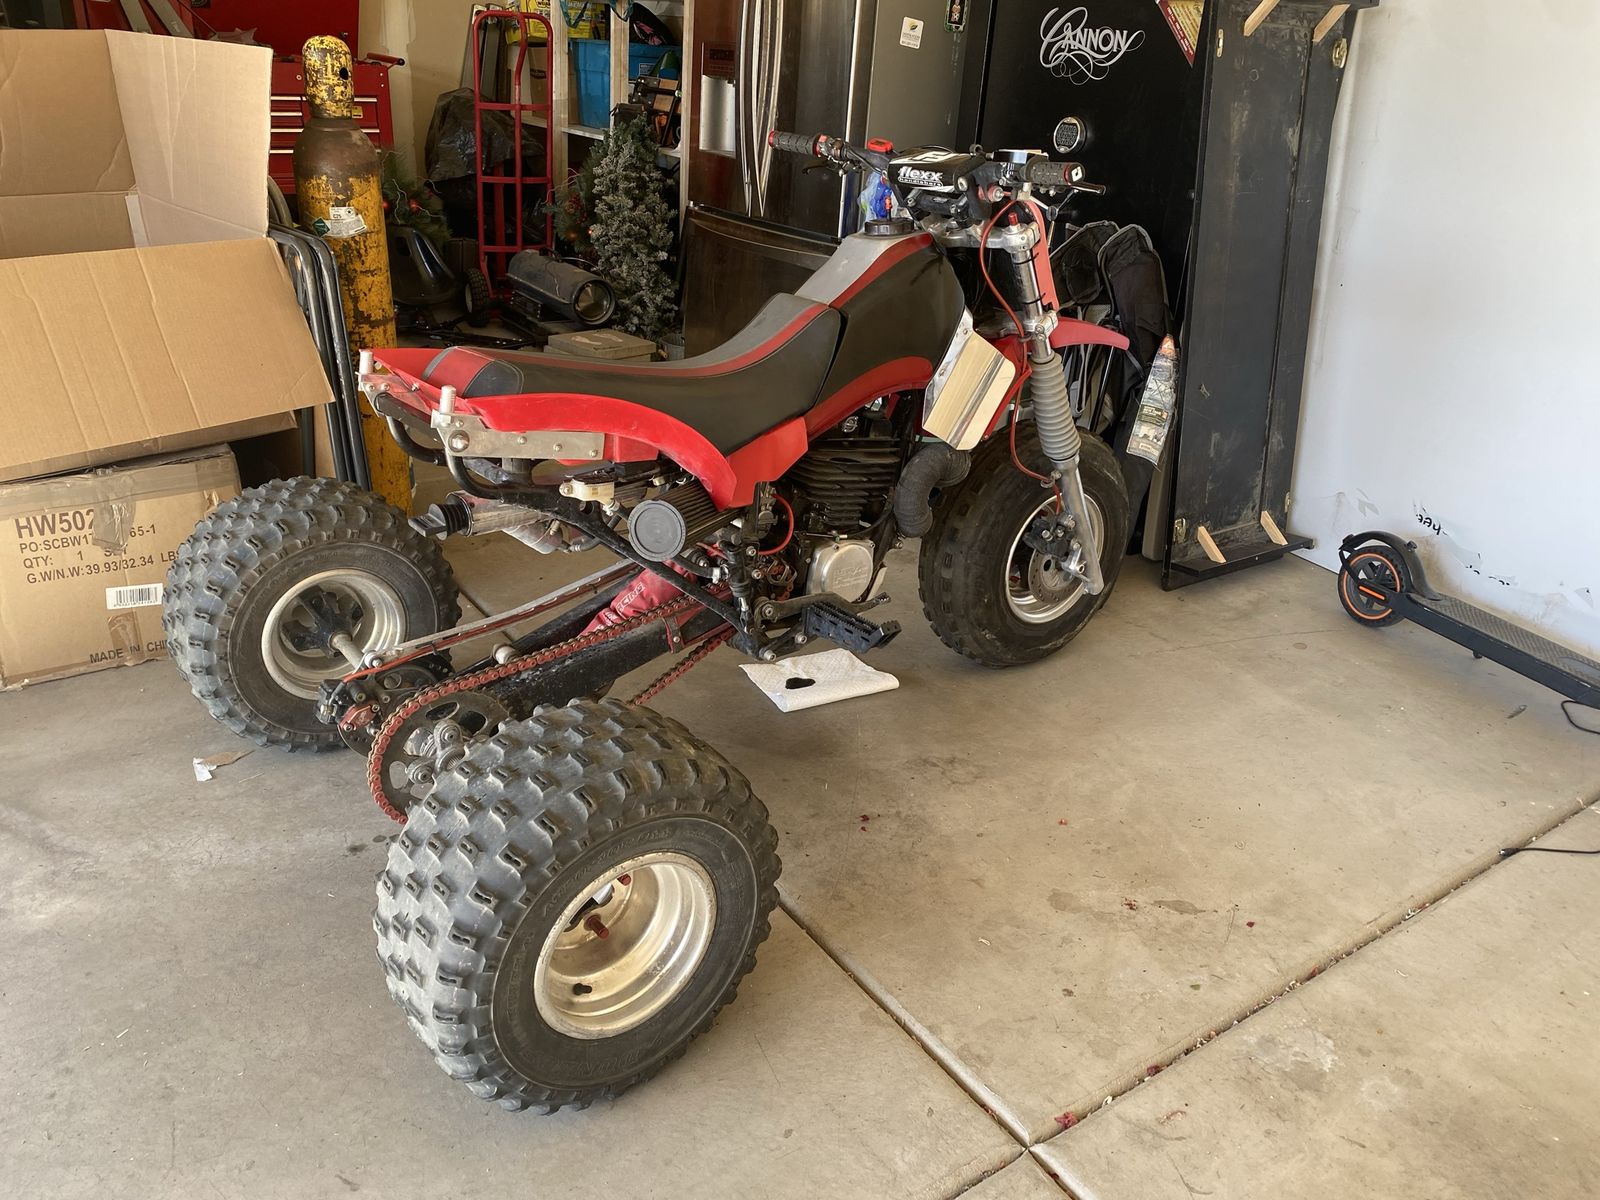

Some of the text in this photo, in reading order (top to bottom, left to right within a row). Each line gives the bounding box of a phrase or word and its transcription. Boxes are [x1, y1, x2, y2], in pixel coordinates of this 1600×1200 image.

[1040, 6, 1146, 85] CANNON
[898, 166, 943, 181] flexx
[20, 533, 93, 554] PO:SCBW1
[23, 544, 128, 569] QTY: 1 ST
[89, 639, 168, 664] MADE IN CHI
